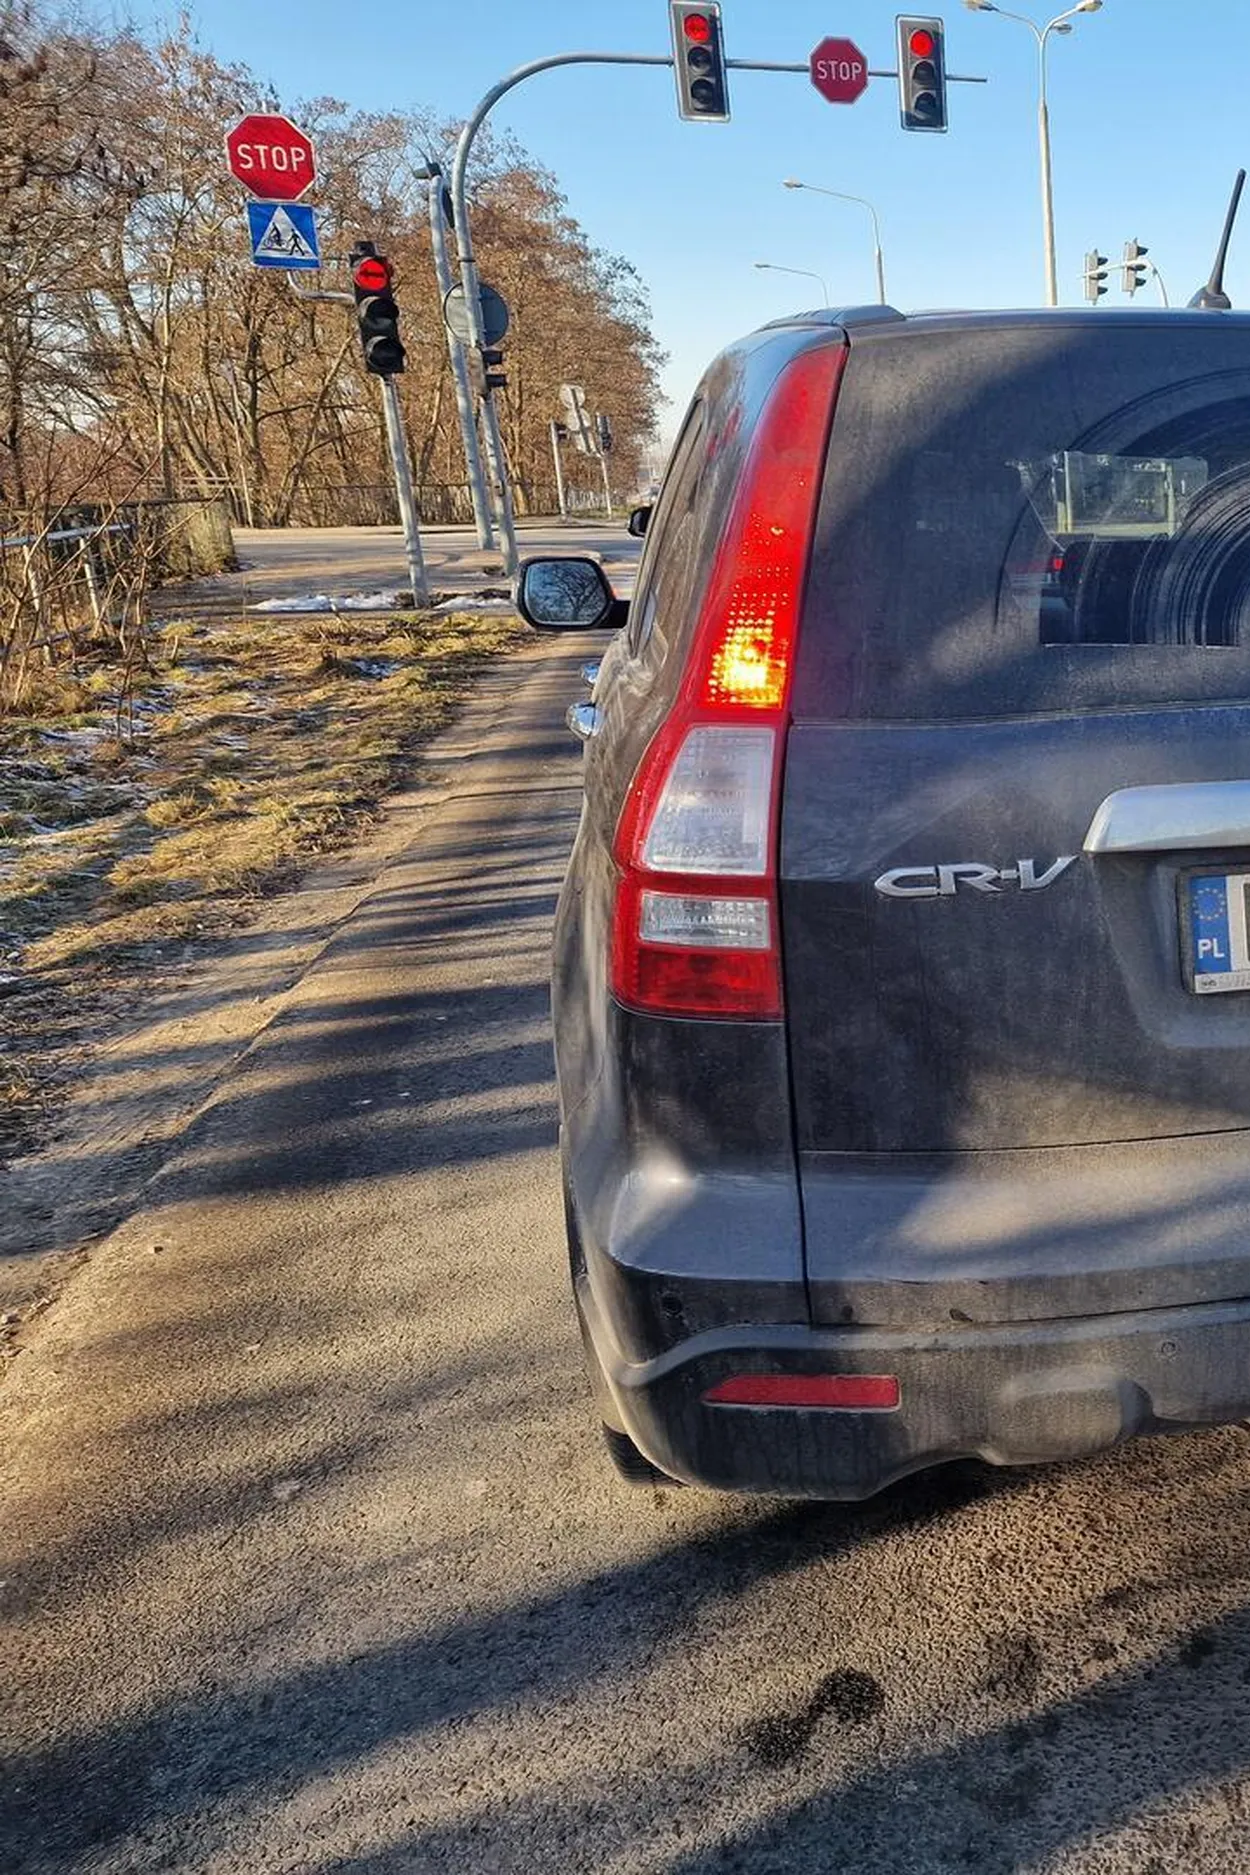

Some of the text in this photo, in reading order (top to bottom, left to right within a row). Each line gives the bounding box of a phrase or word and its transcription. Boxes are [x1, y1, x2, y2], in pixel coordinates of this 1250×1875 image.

[817, 60, 863, 81] STOP
[237, 143, 306, 172] STOP
[874, 854, 1080, 897] CR-V
[1198, 938, 1226, 960] PL
